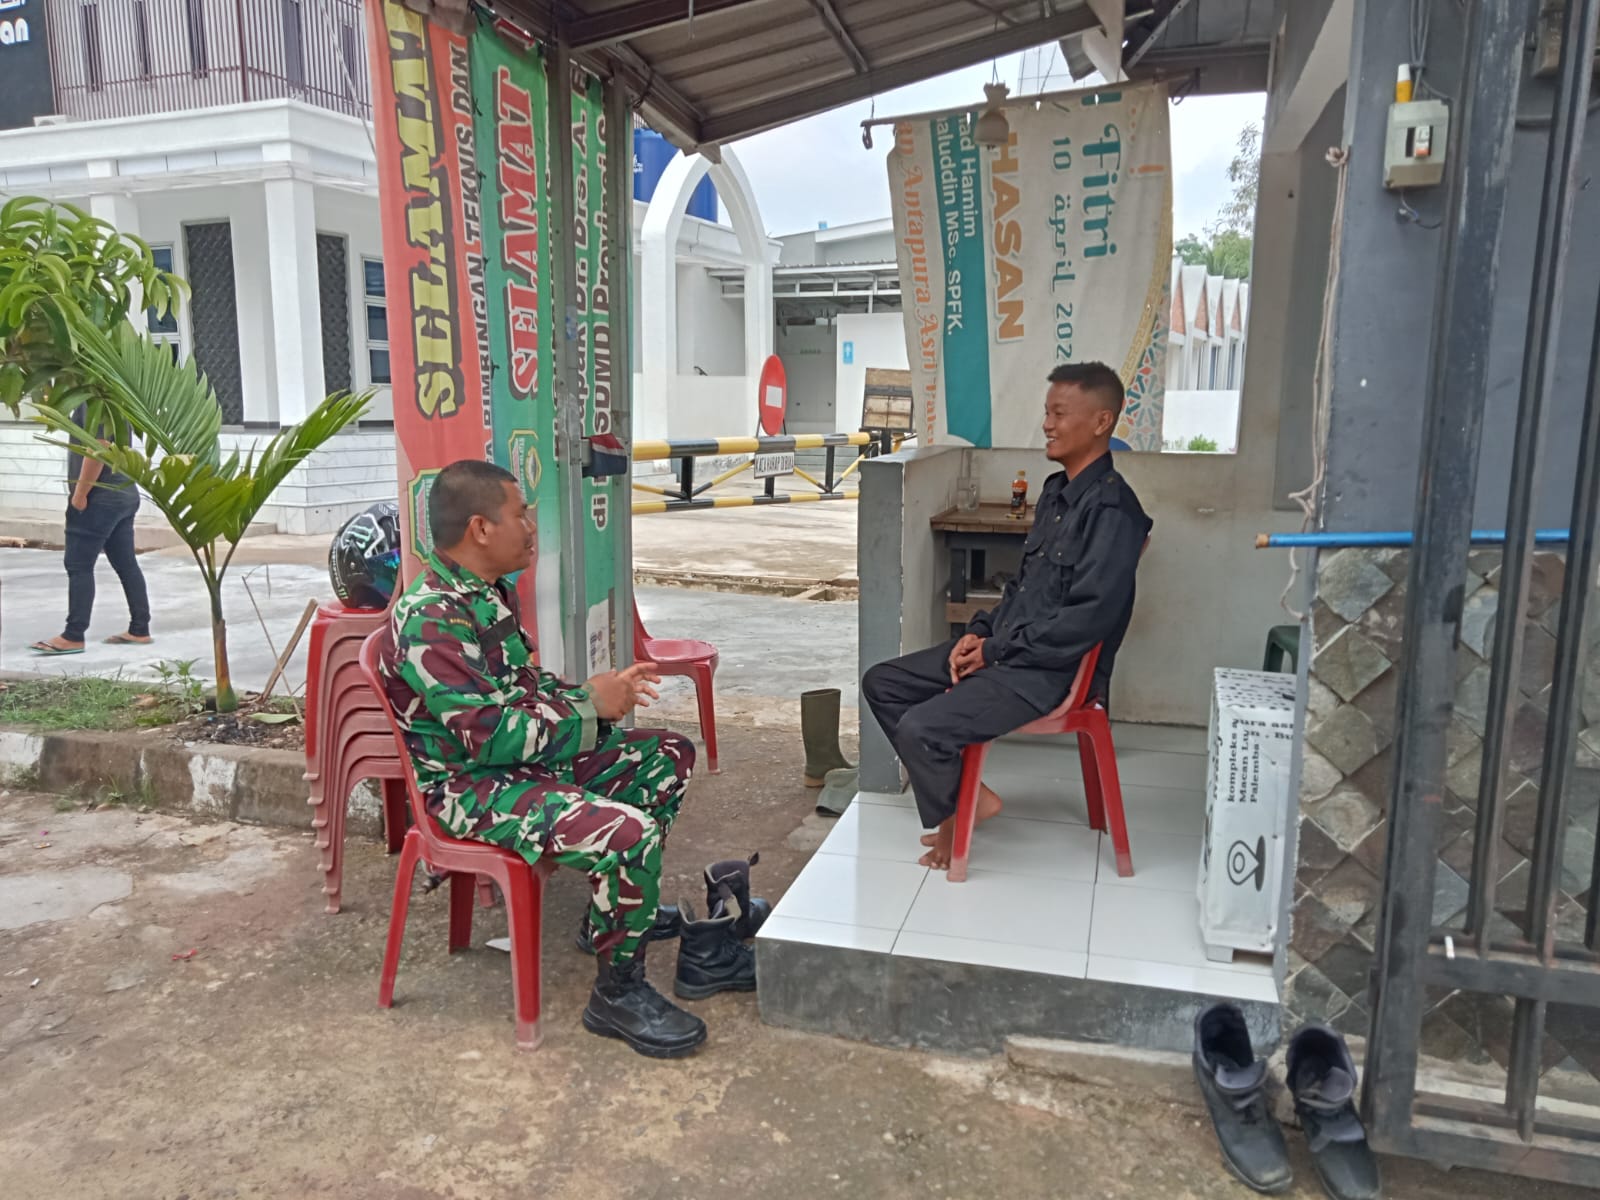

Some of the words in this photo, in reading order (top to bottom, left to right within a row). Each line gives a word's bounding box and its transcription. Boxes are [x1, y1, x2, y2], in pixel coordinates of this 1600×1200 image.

[451, 46, 472, 114] DAN
[572, 112, 587, 158] A.
[1052, 137, 1072, 170] 10
[384, 1, 456, 416] SELAMAT
[456, 124, 480, 242] TEKNIS
[574, 167, 588, 247] Drs.
[961, 157, 979, 238] Hamim
[1082, 123, 1121, 258] Fitri
[498, 66, 538, 392] SELAMAT
[901, 161, 932, 304] Antapura
[917, 309, 939, 370] Asri
[992, 132, 1024, 339] HASAN
[1056, 302, 1073, 361] 202
[577, 325, 589, 436] apak
[594, 497, 607, 528] di
[1228, 732, 1238, 803] kompleks
[1239, 756, 1249, 803] Macan
